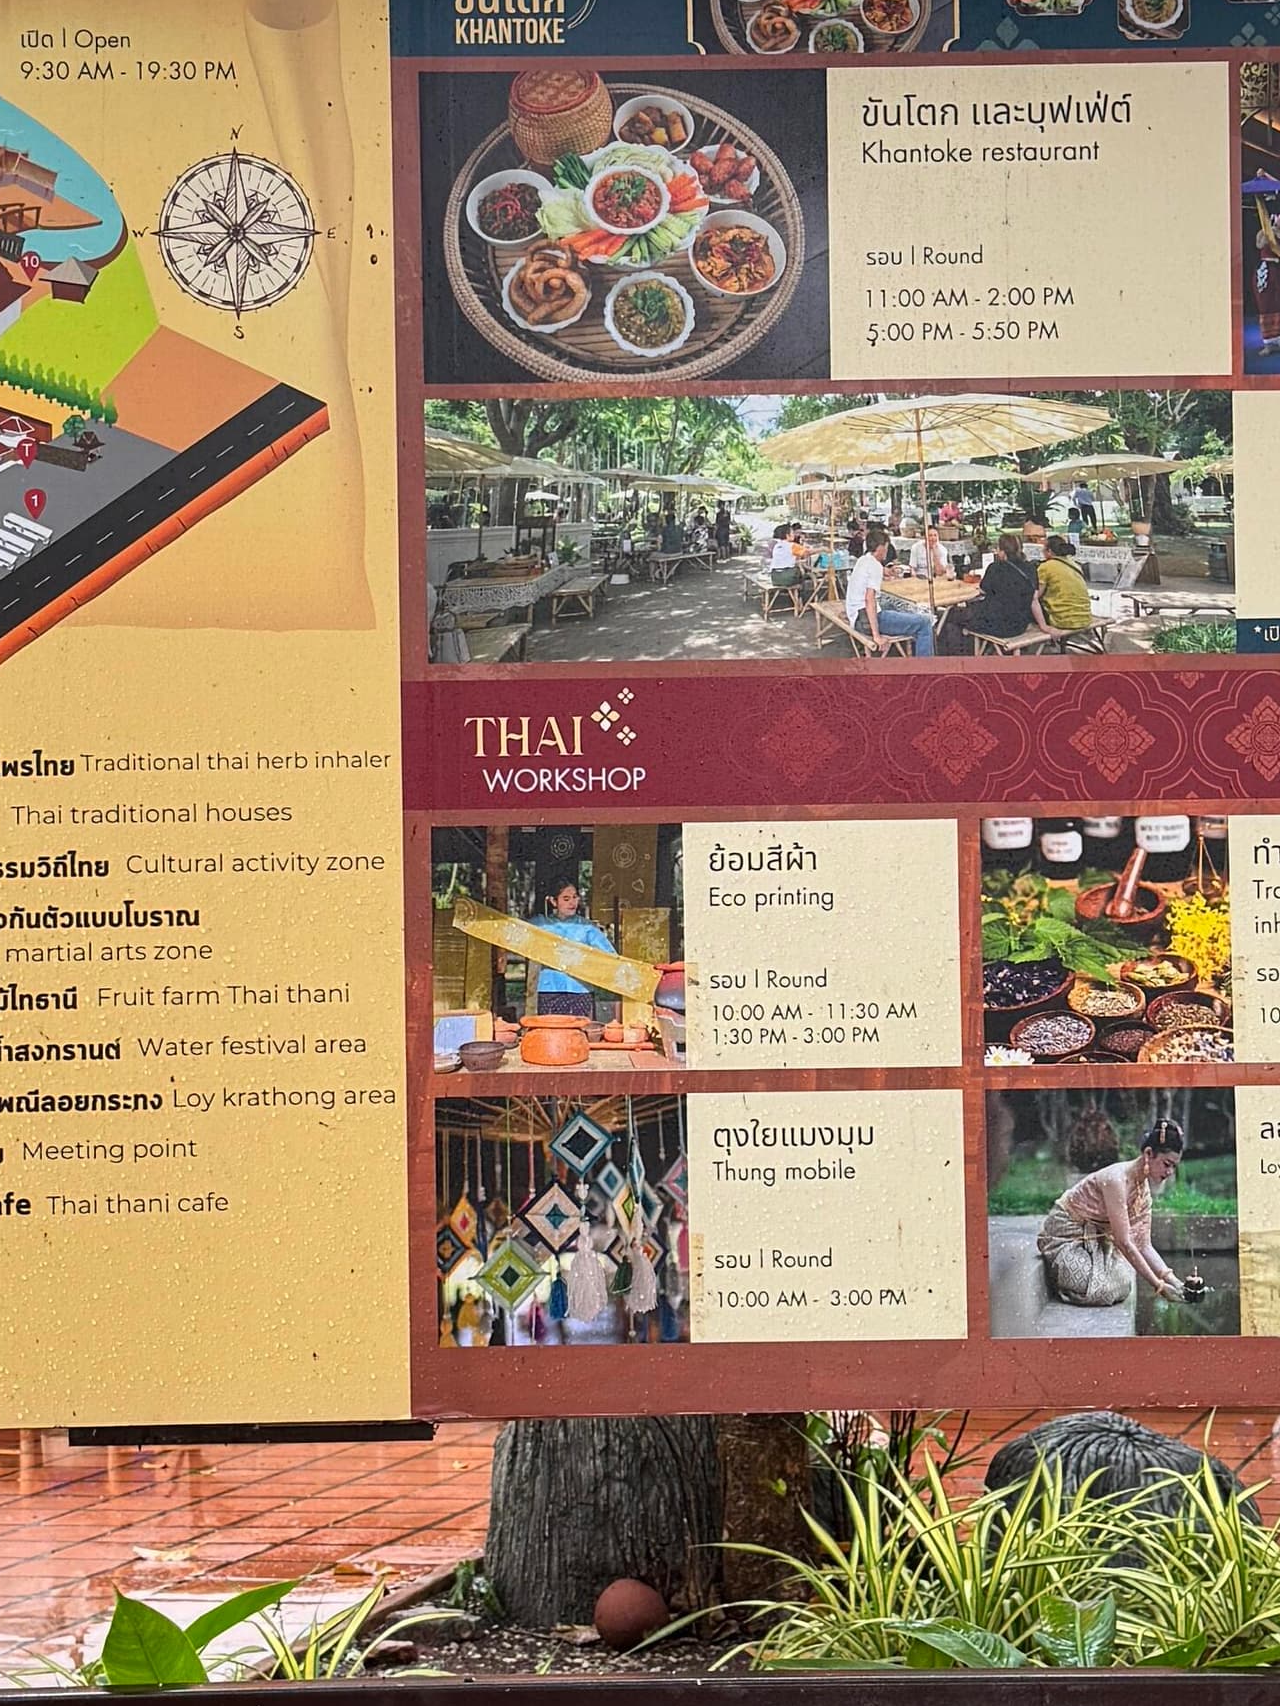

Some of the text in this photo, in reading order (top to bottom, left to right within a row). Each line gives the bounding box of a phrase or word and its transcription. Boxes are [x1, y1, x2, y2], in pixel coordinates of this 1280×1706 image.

[21, 29, 130, 54] เปิด Open
[456, 18, 565, 44] KHANTOKE
[21, 61, 236, 80] 9:30 AM 19:30 PM
[863, 95, 958, 126] ขันโตก
[230, 124, 243, 140] N
[863, 139, 1099, 163] Khantoke restaurant
[132, 227, 149, 237] W
[327, 229, 335, 239] E
[867, 245, 983, 265] รอบ Round
[867, 287, 1074, 307] 11:00 AM 2:00 PM
[234, 326, 244, 339] S
[464, 716, 583, 756] THAI
[80, 753, 199, 771] Traditional
[207, 752, 248, 770] thai
[258, 752, 307, 769] herb
[316, 751, 391, 768] inhaler
[483, 768, 645, 792] WORKSHOP
[11, 805, 61, 824] Thai
[71, 804, 196, 824] traditional
[207, 803, 292, 821] houses
[127, 853, 222, 873] Cultural
[232, 855, 319, 875] activity
[327, 856, 384, 870] zone
[710, 842, 816, 871] ย้อมสีผ้า
[710, 887, 833, 912] Eco printing
[6, 942, 91, 962] martial
[101, 944, 146, 961] arts
[154, 945, 212, 960] zone
[99, 988, 155, 1006] Fruit
[162, 986, 219, 1005] farm
[227, 986, 278, 1004] Thai
[287, 984, 349, 1003] thani
[138, 1038, 213, 1056] Water
[221, 1035, 305, 1055] festival
[315, 1039, 366, 1053] area
[714, 1119, 873, 1156] ตุงใยแมงมุม
[24, 1142, 123, 1163] Meeting
[134, 1140, 197, 1163] point
[712, 1159, 855, 1186] Thung mobile
[46, 1195, 97, 1214] Thai
[106, 1194, 169, 1213] thani
[178, 1192, 228, 1211] cafe
